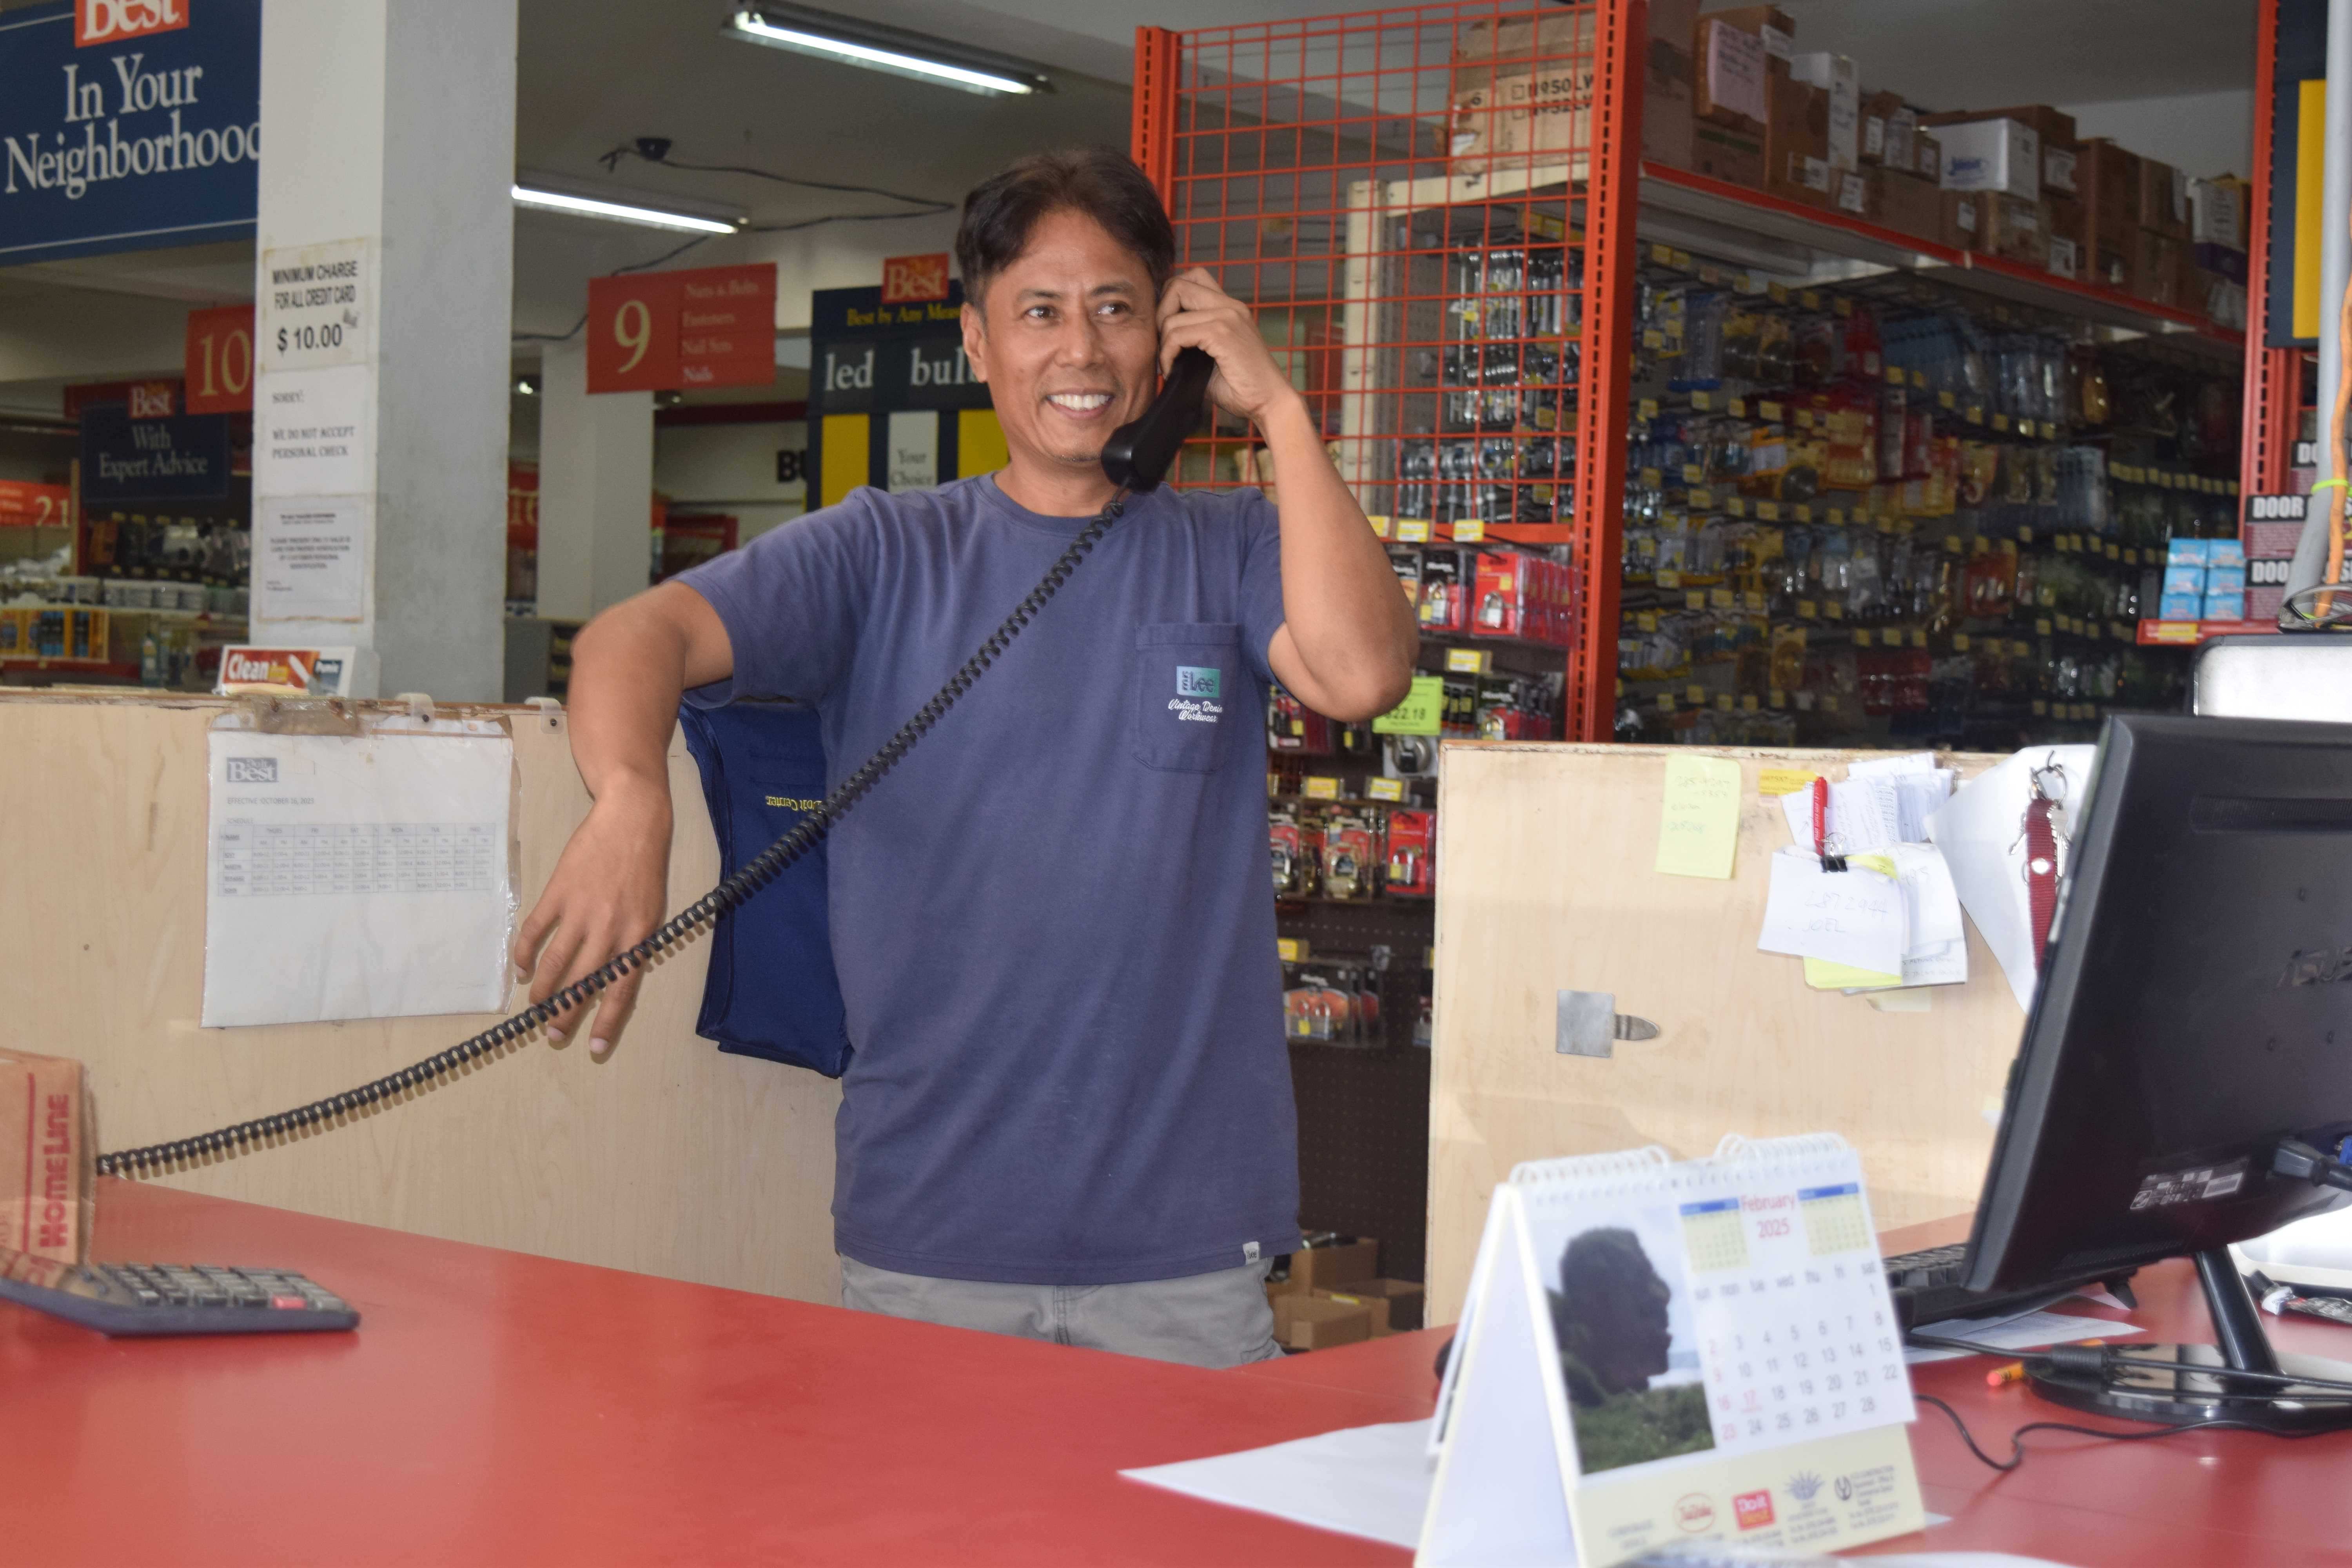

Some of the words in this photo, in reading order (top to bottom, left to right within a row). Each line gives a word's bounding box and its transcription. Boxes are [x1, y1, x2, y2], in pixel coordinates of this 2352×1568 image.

[82, 0, 180, 40] Best
[63, 64, 105, 122] In
[112, 53, 203, 114] Your
[272, 266, 314, 285] MINIMUM
[317, 260, 358, 280] CHARGE
[886, 265, 946, 301] Best
[275, 291, 289, 309] FOR
[292, 291, 304, 307] ALL
[305, 287, 332, 306] CREDIT
[334, 285, 356, 304] CARD
[277, 326, 288, 357] $
[294, 323, 342, 349] 10.00
[614, 300, 651, 374] 9
[199, 328, 252, 396] 10
[826, 349, 874, 391] led
[910, 344, 986, 386] bul
[131, 386, 171, 415] Best
[132, 423, 171, 449] With
[320, 425, 355, 439] ACCEPT
[99, 452, 149, 483] Expert
[153, 450, 208, 476] Advice
[2252, 496, 2304, 518] DOOR
[2251, 561, 2290, 583] DOO
[228, 653, 270, 681] Clean
[1189, 671, 1214, 693] Lee
[1168, 699, 1201, 713] Vintage
[1178, 710, 1218, 723] Workwear
[229, 761, 276, 782] Best
[766, 796, 799, 811] Center
[1740, 1194, 1795, 1212] February
[1757, 1218, 1790, 1239] 2025
[1861, 1261, 1876, 1275] sat
[1738, 1362, 1752, 1378] 10
[1766, 1357, 1779, 1373] 11
[1793, 1352, 1808, 1368] 12
[1821, 1347, 1837, 1363] 13
[1849, 1342, 1864, 1357] 14
[1878, 1337, 1892, 1352] 15
[1772, 1385, 1785, 1401] 18
[1800, 1379, 1814, 1396] 19
[1826, 1374, 1842, 1391] 20
[1854, 1369, 1869, 1387] 21
[1883, 1363, 1898, 1380] 22
[1748, 1418, 1762, 1436] 24
[1776, 1412, 1791, 1430] 25
[1804, 1406, 1819, 1424] 26
[1832, 1401, 1847, 1419] 27
[1860, 1396, 1875, 1413] 28
